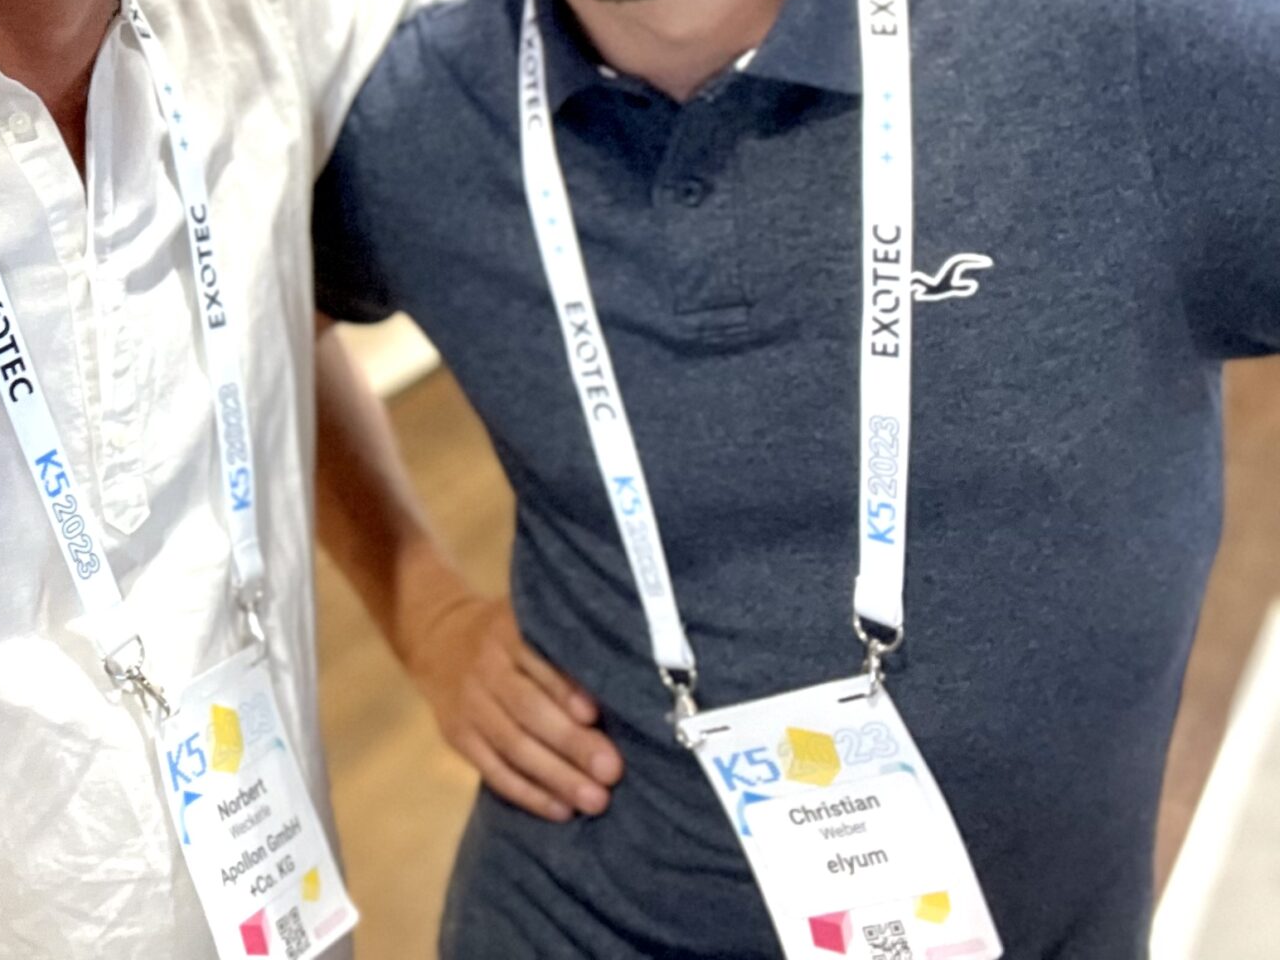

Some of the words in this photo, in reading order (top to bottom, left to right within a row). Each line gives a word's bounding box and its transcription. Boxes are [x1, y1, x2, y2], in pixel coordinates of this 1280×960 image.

[190, 203, 226, 330] EXOTEC
[872, 225, 902, 358] EXOTEC
[565, 300, 617, 422] EXOTEC
[713, 746, 781, 792] K5
[217, 778, 268, 822] Norbert
[788, 794, 881, 826] Christian
[221, 845, 268, 886] Apollon
[266, 814, 302, 852] GmbH
[819, 821, 868, 840] Weber
[276, 854, 296, 879] KG
[826, 846, 889, 876] elyum
